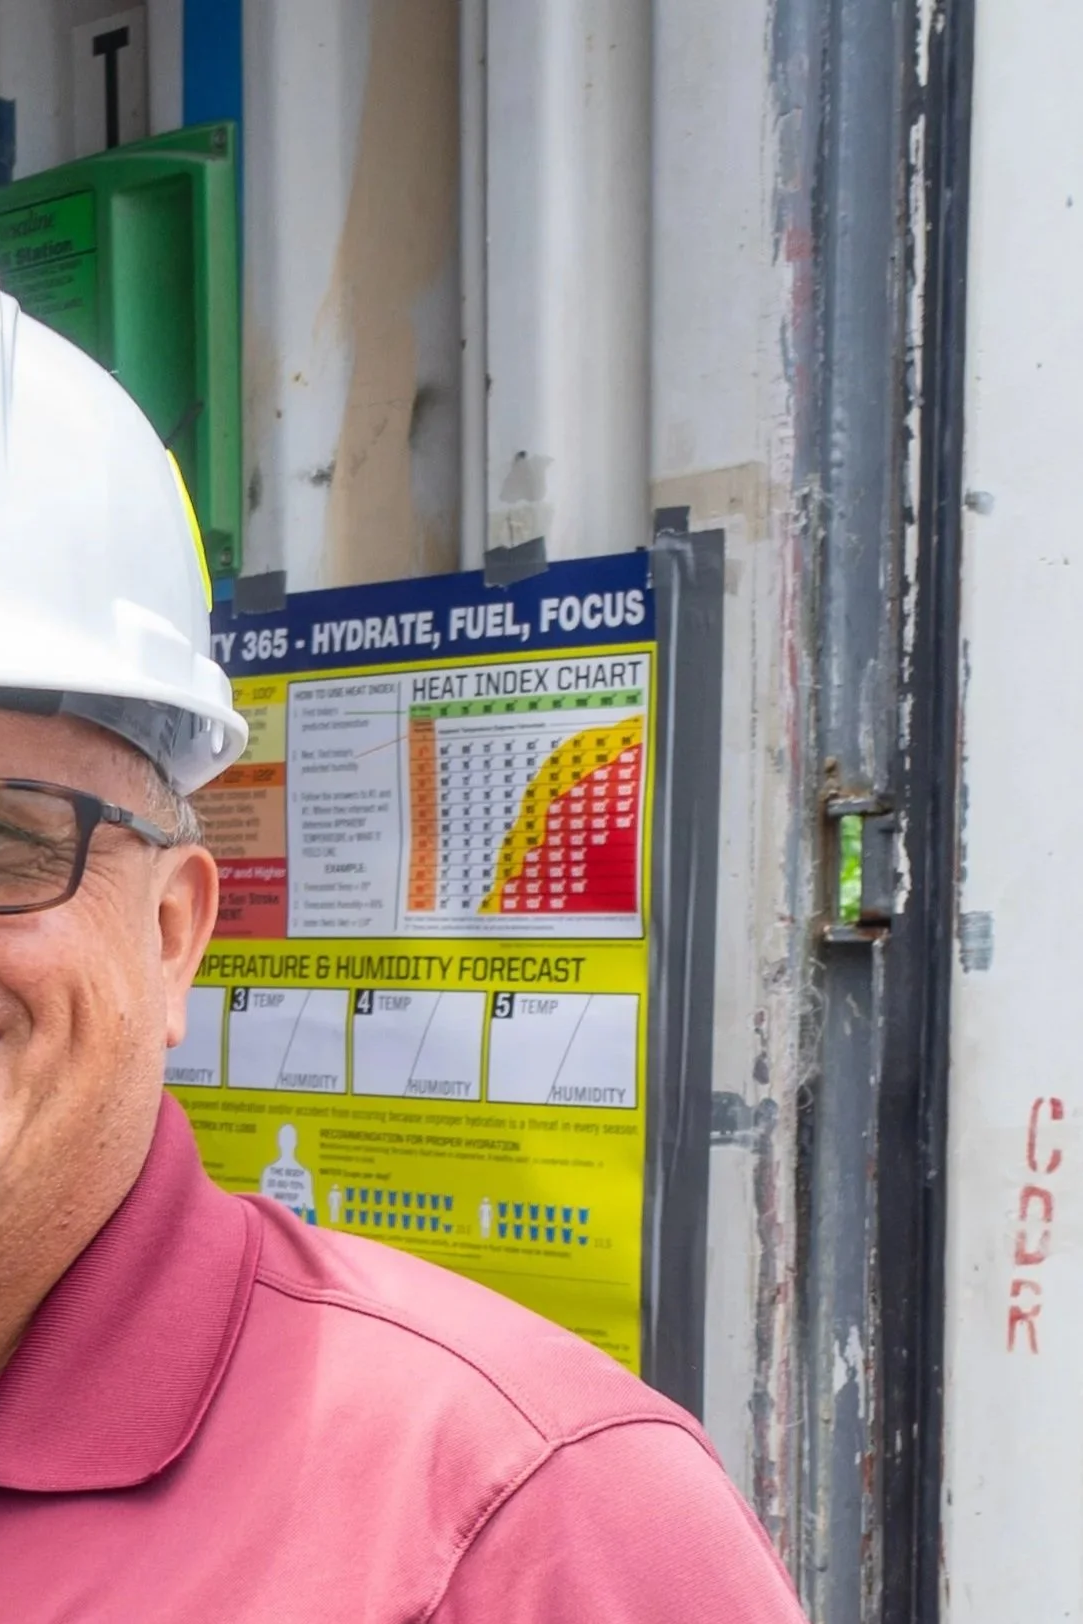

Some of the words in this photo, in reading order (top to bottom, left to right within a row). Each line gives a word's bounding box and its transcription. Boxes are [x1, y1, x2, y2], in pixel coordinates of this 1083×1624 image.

[242, 628, 288, 661] 365
[311, 611, 441, 655] HYDRATE,
[449, 602, 531, 642] FUEL,
[540, 589, 646, 633] FOCUS
[412, 674, 468, 701] HEAT
[474, 667, 549, 697] INDEX
[557, 661, 642, 691] CHART
[315, 955, 331, 978] &
[335, 955, 454, 980] HUMIDITY
[458, 956, 586, 983] FORECAST
[232, 988, 248, 1011] 3
[253, 992, 285, 1008] TEMP
[356, 989, 372, 1013] 4
[378, 995, 412, 1011] TEMP
[495, 992, 512, 1018] 5
[520, 998, 559, 1015] TEMP
[279, 1072, 339, 1090] HUMIDITY
[407, 1078, 471, 1097] HUMIDITY
[550, 1085, 627, 1104] HUMIDITY
[319, 1128, 403, 1143] RECOMMENDATION
[406, 1133, 422, 1145] FOR
[425, 1134, 463, 1148] PROPER
